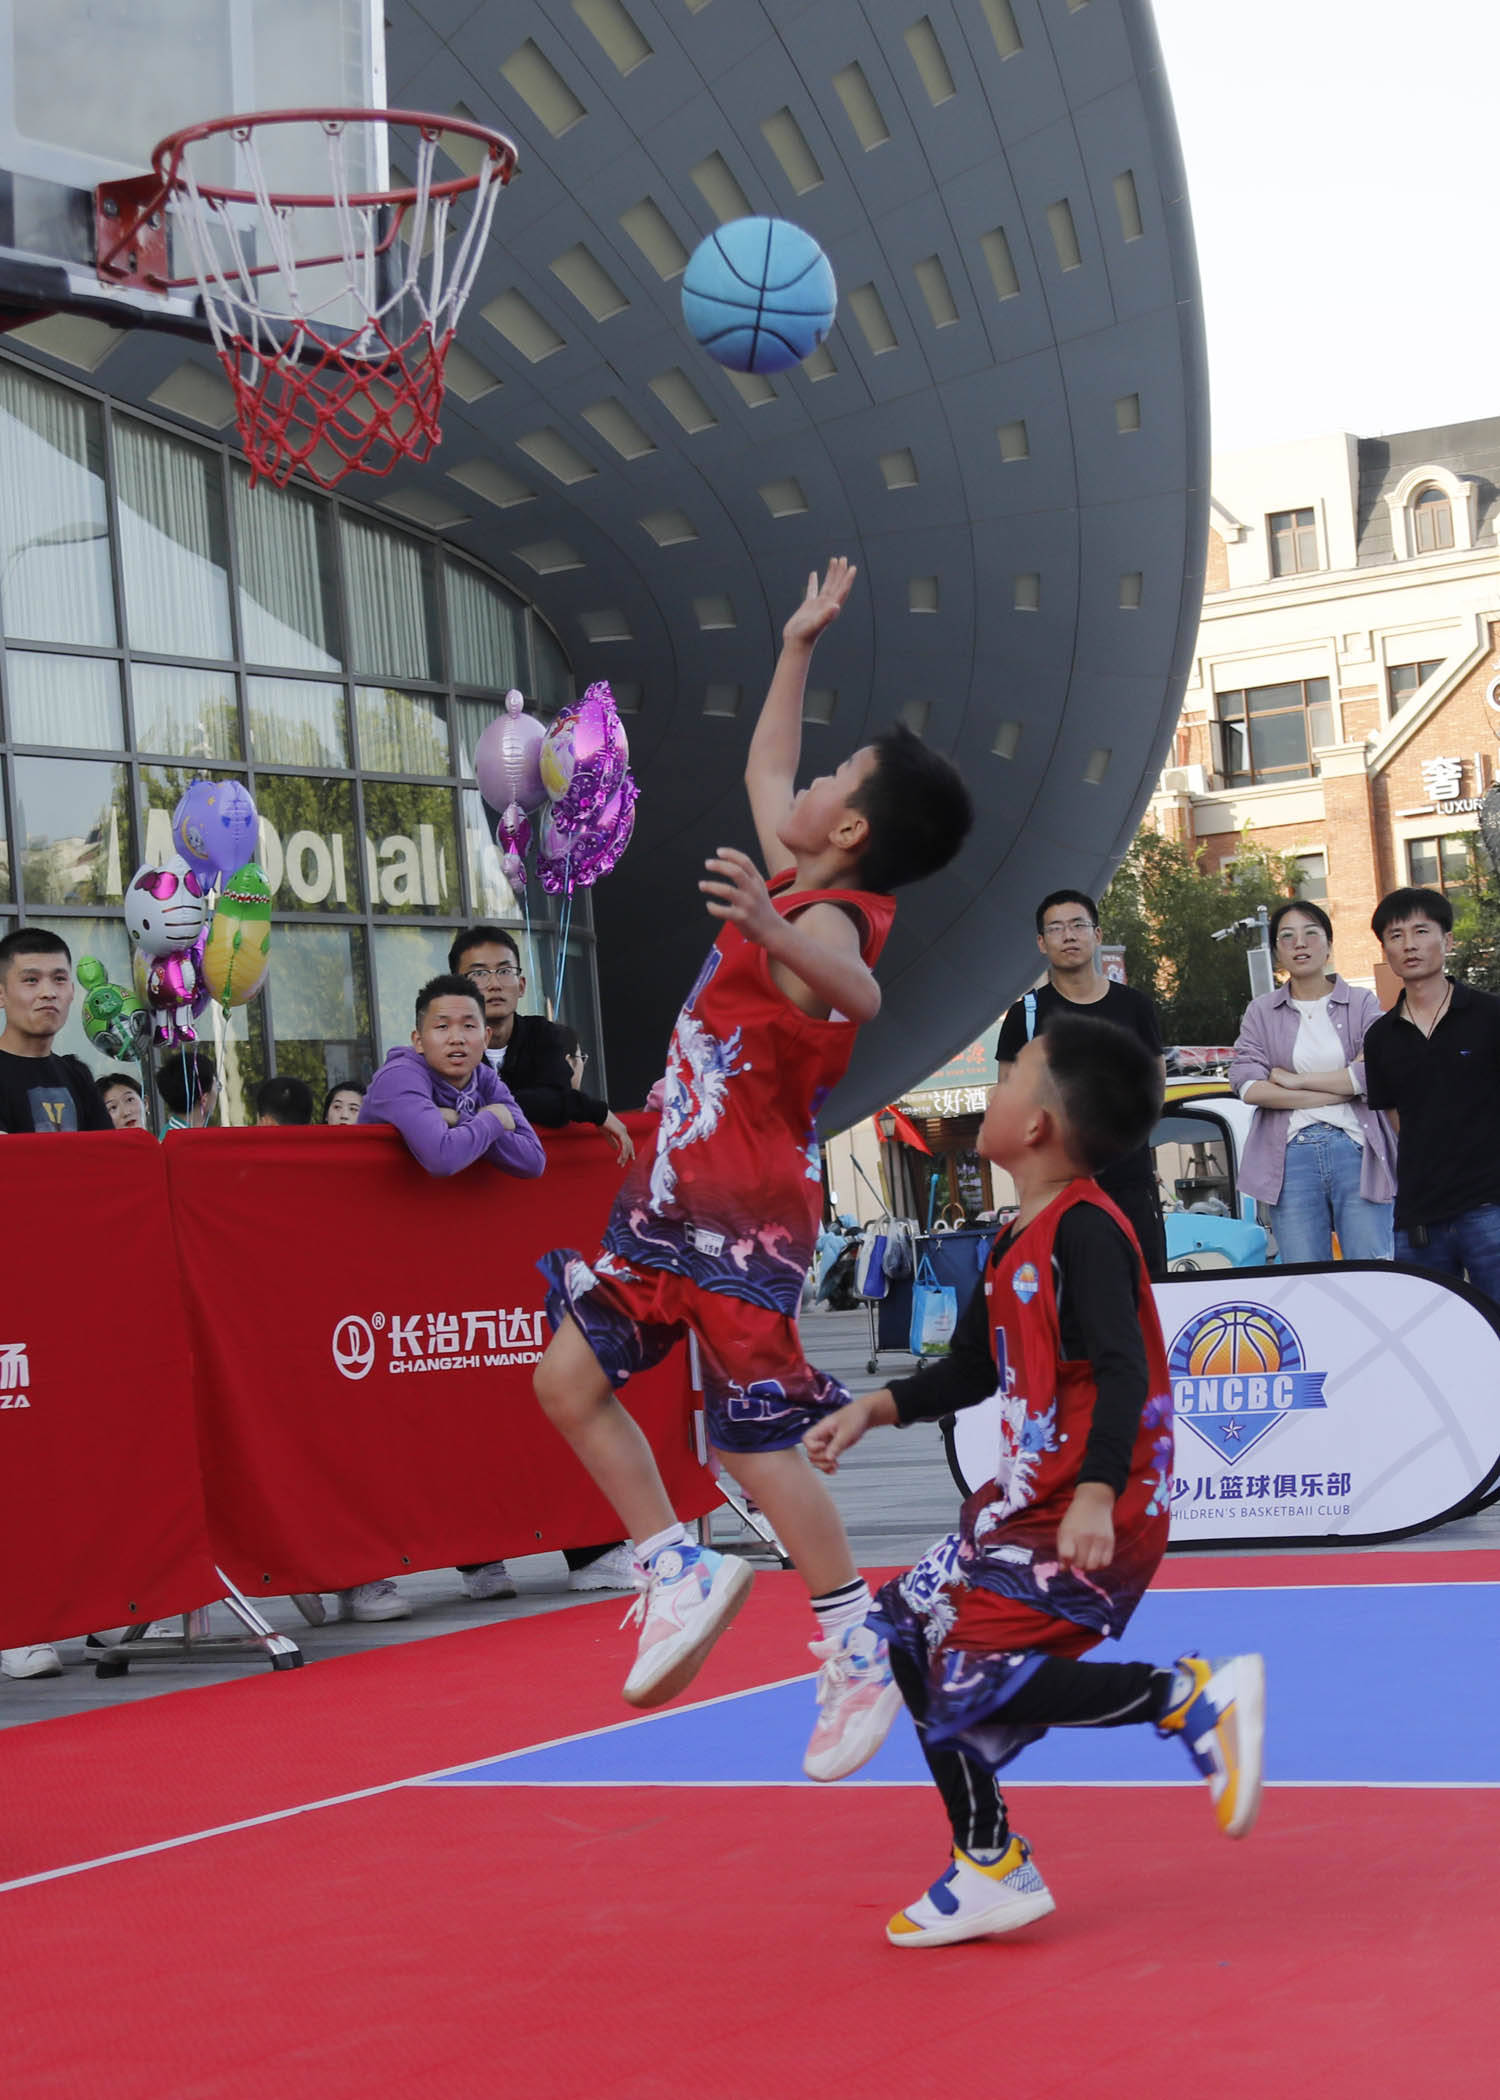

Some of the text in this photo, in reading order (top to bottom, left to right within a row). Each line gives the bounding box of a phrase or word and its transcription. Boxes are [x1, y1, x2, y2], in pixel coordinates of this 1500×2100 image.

[1436, 798, 1486, 815] LUXUR
[389, 1351, 545, 1374] CHANGZHI WANDA
[1173, 1375, 1294, 1414] CNCBC
[1170, 1472, 1352, 1502] 少儿篮球俱乐部
[1317, 1504, 1351, 1517] CLUB
